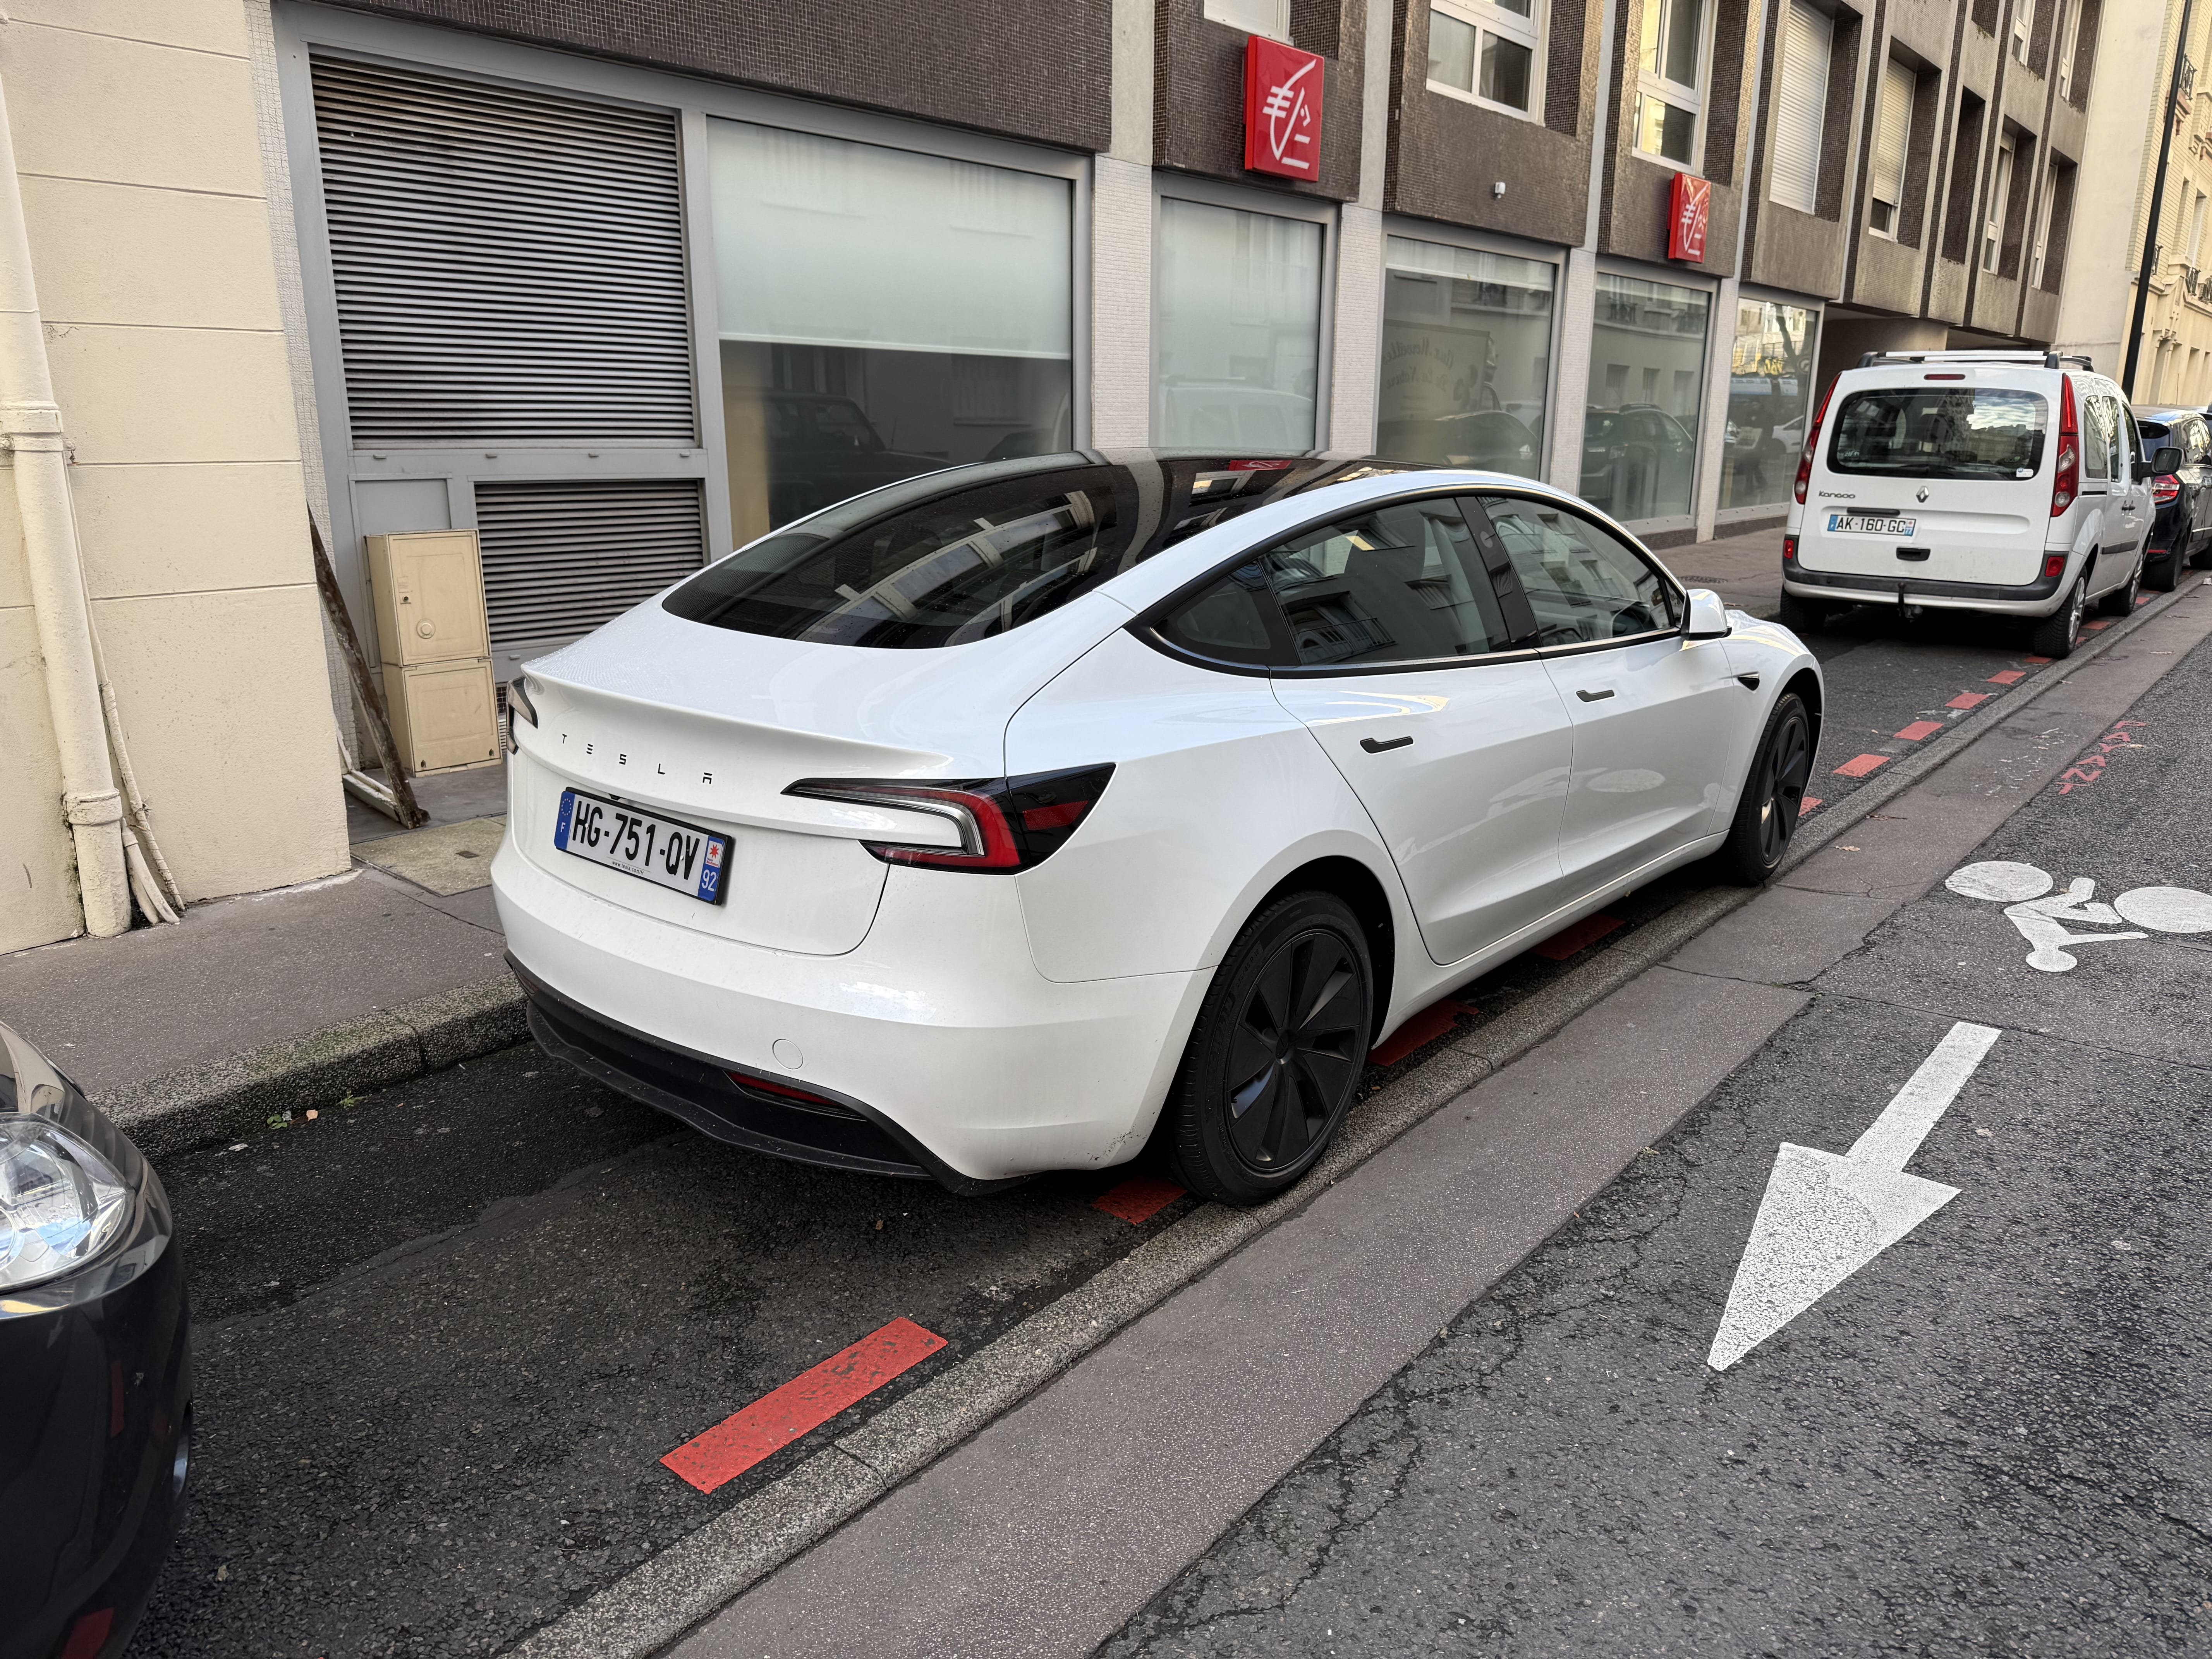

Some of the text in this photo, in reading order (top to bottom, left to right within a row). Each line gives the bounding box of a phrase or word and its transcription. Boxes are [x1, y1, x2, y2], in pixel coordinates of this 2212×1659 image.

[1837, 517, 1906, 533] AK-160-GC
[562, 734, 713, 785] TESLA
[561, 823, 565, 833] F
[572, 801, 700, 880] HG-751-QV
[701, 869, 714, 892] 92
